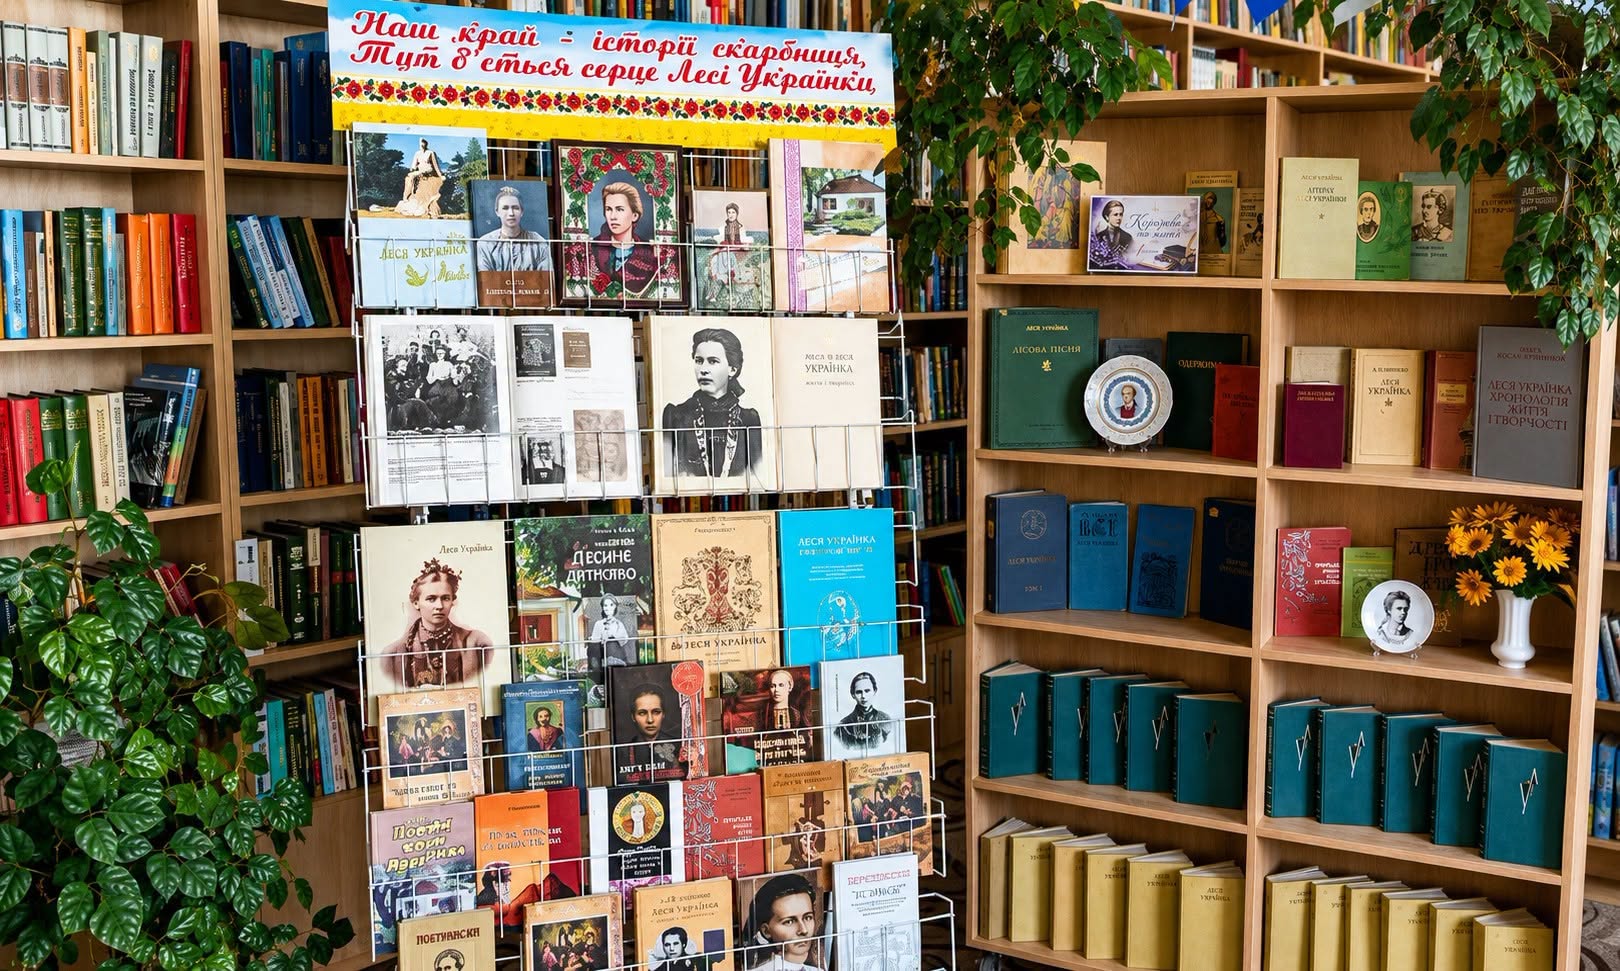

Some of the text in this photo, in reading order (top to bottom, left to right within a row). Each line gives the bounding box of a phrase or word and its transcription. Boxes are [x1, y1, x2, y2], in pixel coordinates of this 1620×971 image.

[351, 10, 440, 40] Наш
[593, 30, 697, 62] історії
[350, 40, 441, 71] Тут
[581, 62, 658, 86] серце
[668, 60, 730, 85] Лесі
[1012, 345, 1081, 354] ЛІСОВА ПІСНЯ
[805, 361, 853, 373] УКРАЇНКА
[1368, 386, 1411, 395] УКРАЇНКА
[1488, 381, 1572, 395] ЛЕСЯ УКРАЇНКА
[1489, 392, 1569, 407] ХРОНОЛОГІЯ
[1508, 404, 1548, 417] ЖИТТЯ
[798, 534, 876, 546] ЛЕСЯ УКРАЇНКА
